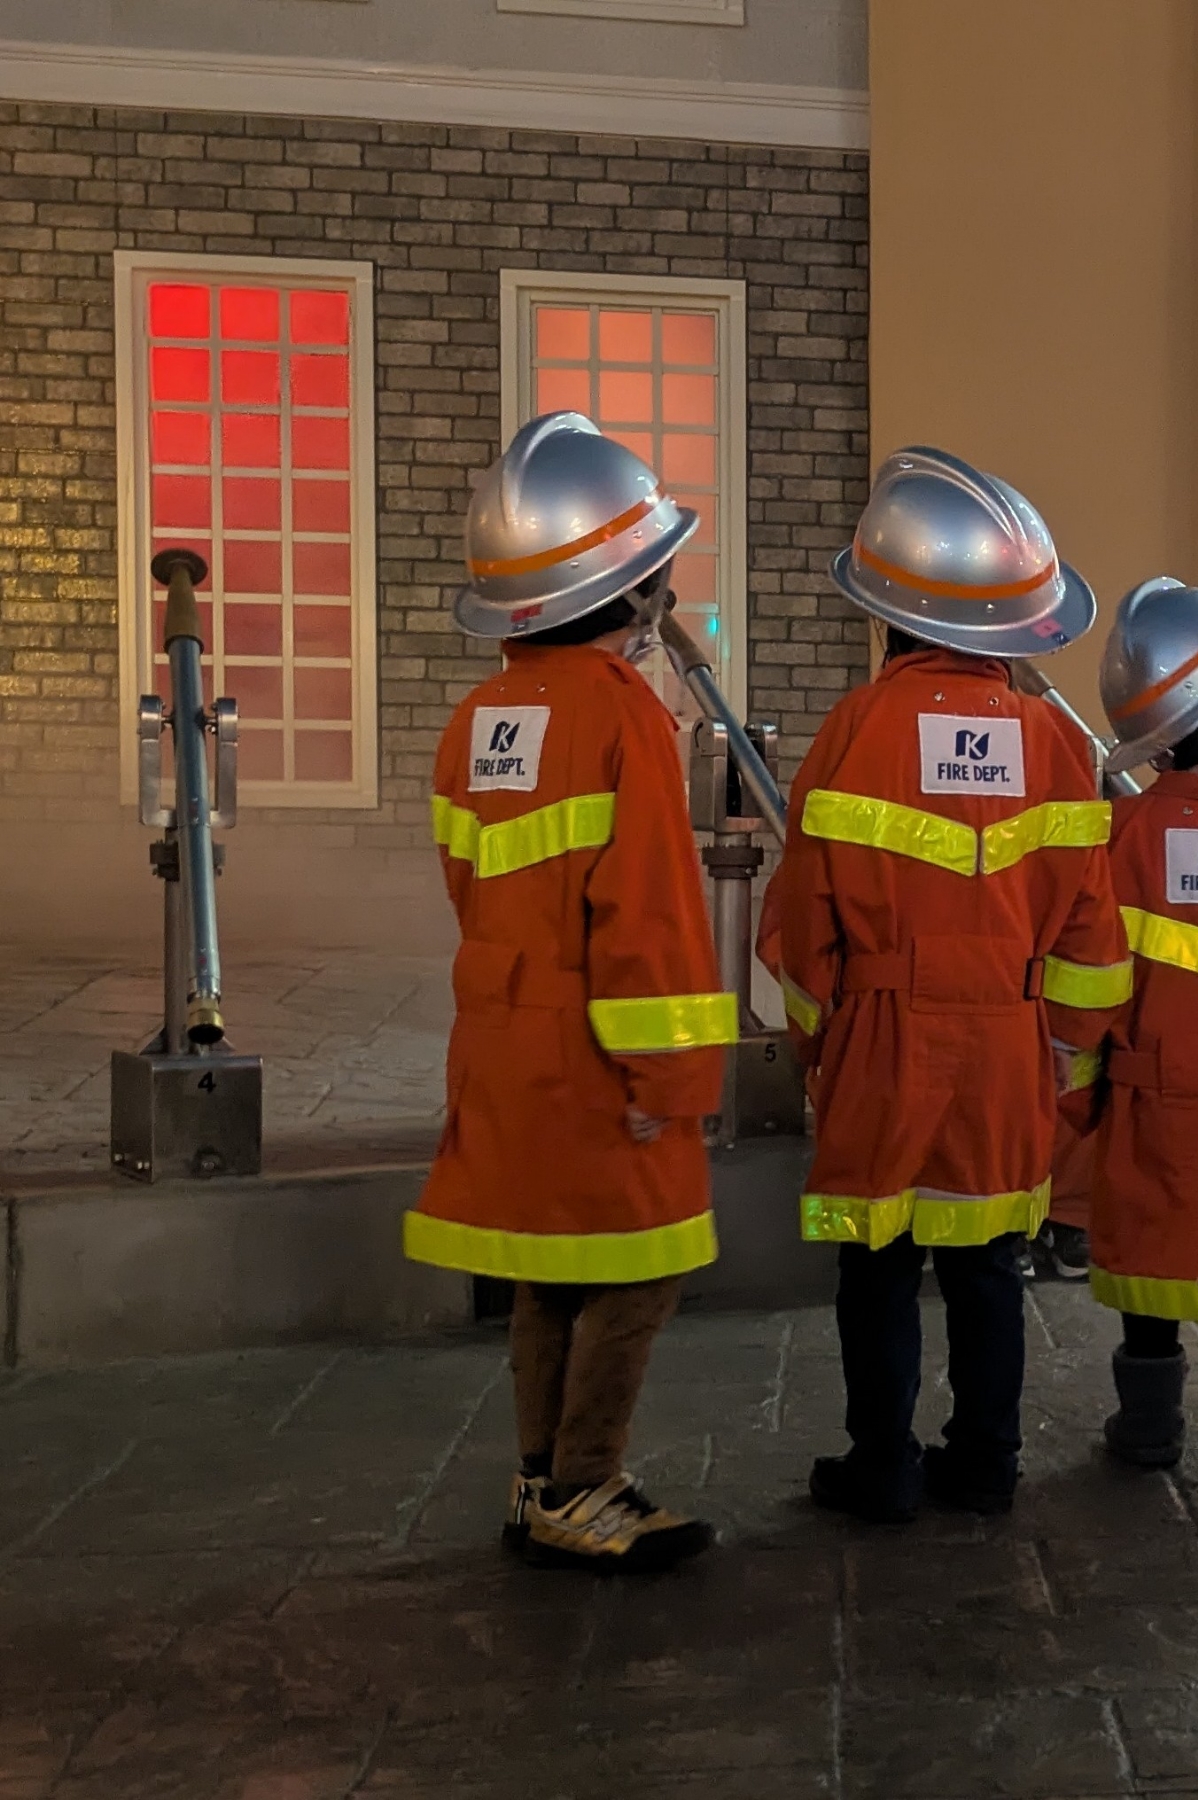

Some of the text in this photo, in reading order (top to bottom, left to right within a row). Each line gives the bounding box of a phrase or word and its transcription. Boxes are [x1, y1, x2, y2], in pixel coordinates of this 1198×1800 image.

[474, 757, 525, 776] FIRE DEPT.
[937, 762, 1011, 783] FIRE DEPT.
[764, 1043, 777, 1063] 5
[197, 1071, 217, 1094] 4
